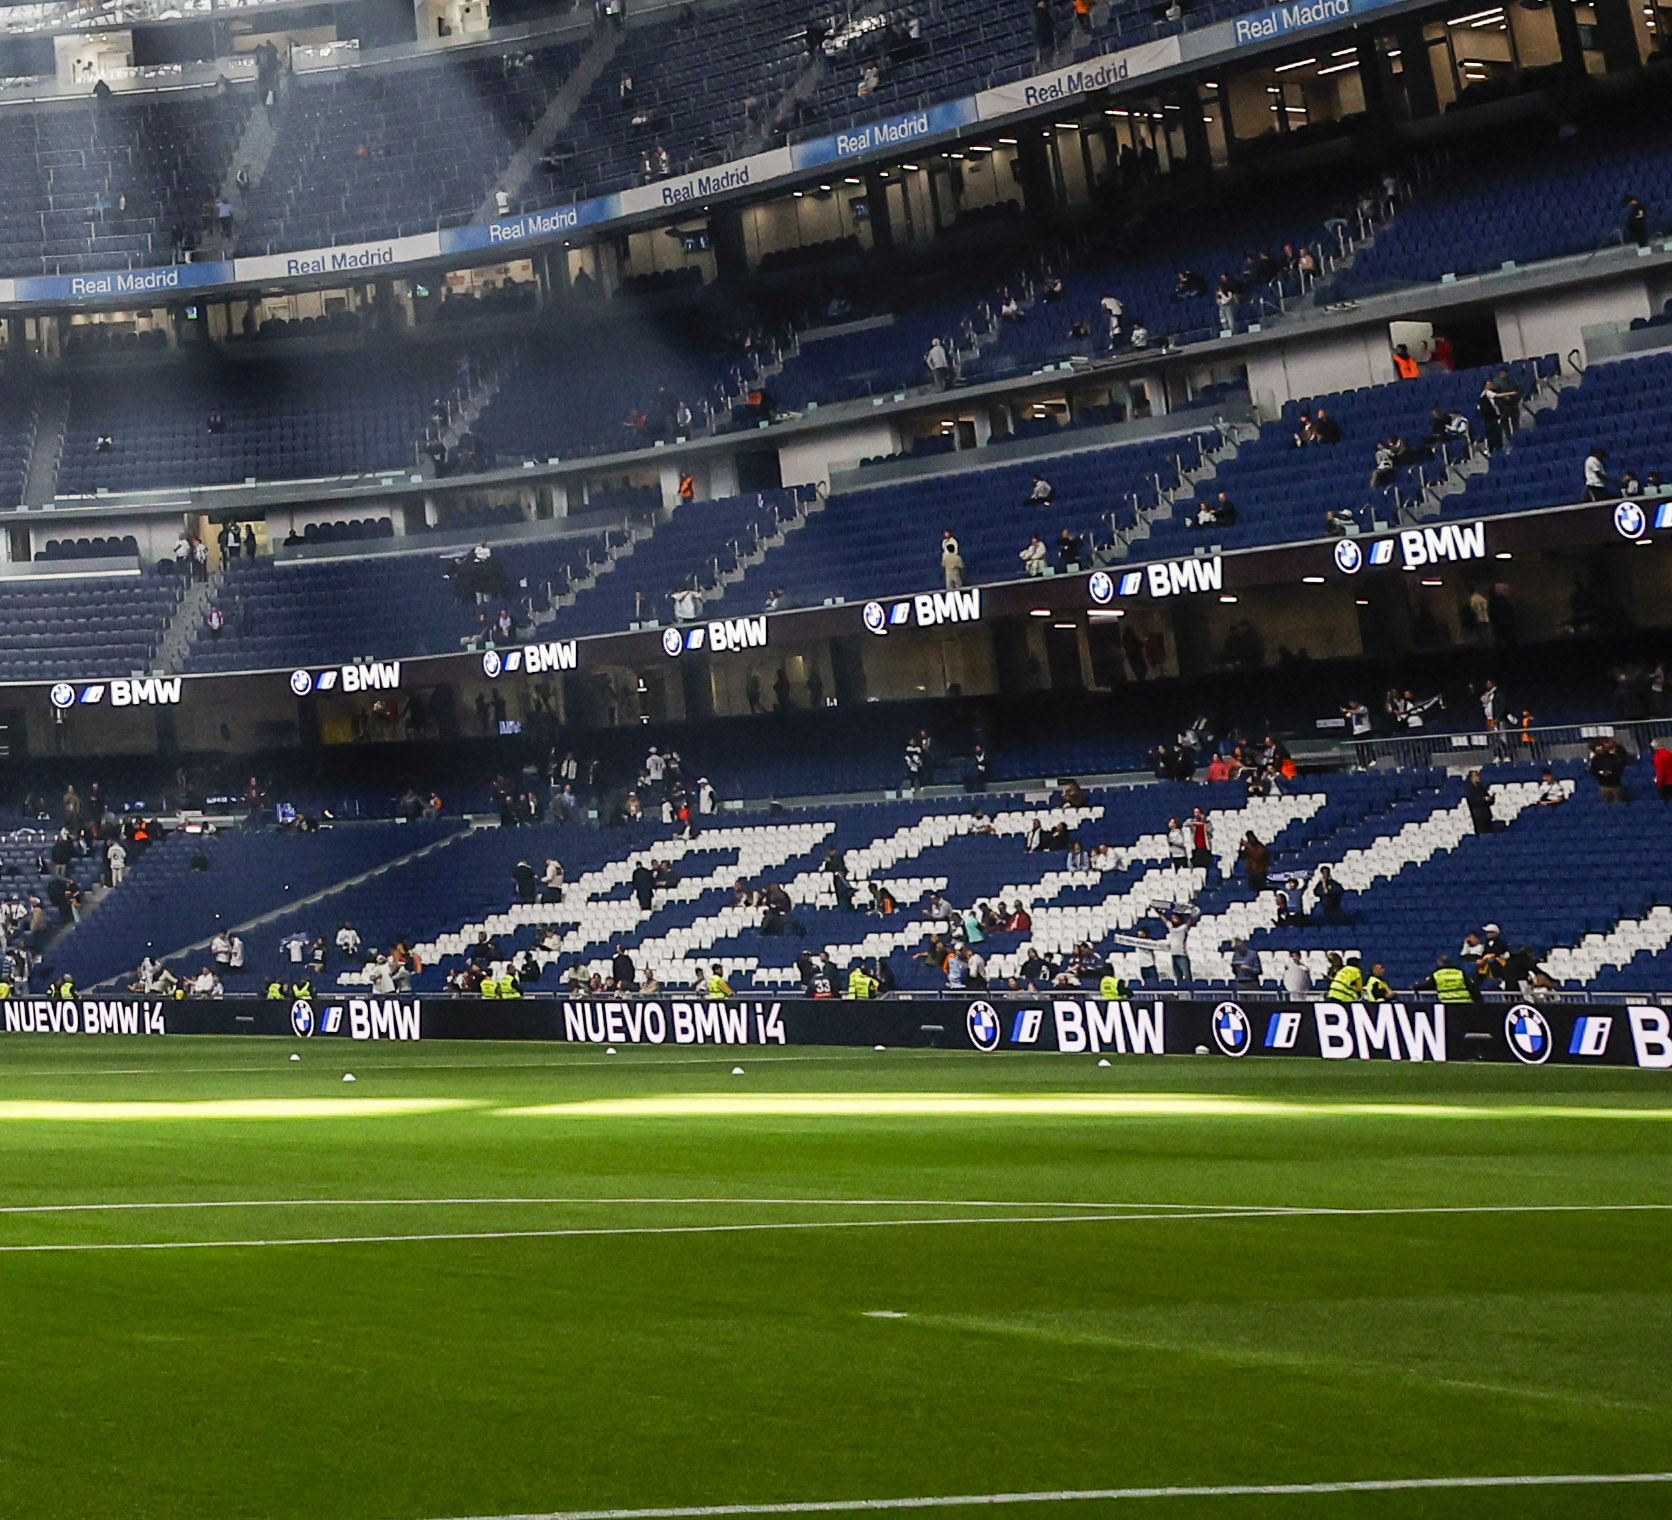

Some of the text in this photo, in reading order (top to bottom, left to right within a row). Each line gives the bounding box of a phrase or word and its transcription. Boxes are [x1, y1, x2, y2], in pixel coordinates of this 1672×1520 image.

[1235, 15, 1278, 43] Real
[1025, 60, 1129, 106] Real Madrid
[837, 113, 929, 155] Real Madrid
[662, 166, 750, 206] Real Madrid
[489, 209, 578, 242] Real Madrid
[287, 247, 393, 276] Real Madrid
[71, 269, 179, 295] Real Madrid
[1401, 521, 1486, 566] BMW
[1147, 556, 1223, 597] BMW
[915, 588, 981, 627] BMW
[708, 616, 767, 650] BMW
[524, 641, 577, 674] BMW
[111, 678, 182, 707] BMW
[341, 662, 400, 692] BMW
[814, 979, 831, 993] 33
[3, 1001, 166, 1035] NUEVO BMW i4
[348, 999, 421, 1040] BMW
[562, 1001, 787, 1045] NUEVO BMW i4
[1052, 1000, 1165, 1054] BMW
[1313, 1002, 1447, 1062] BMW
